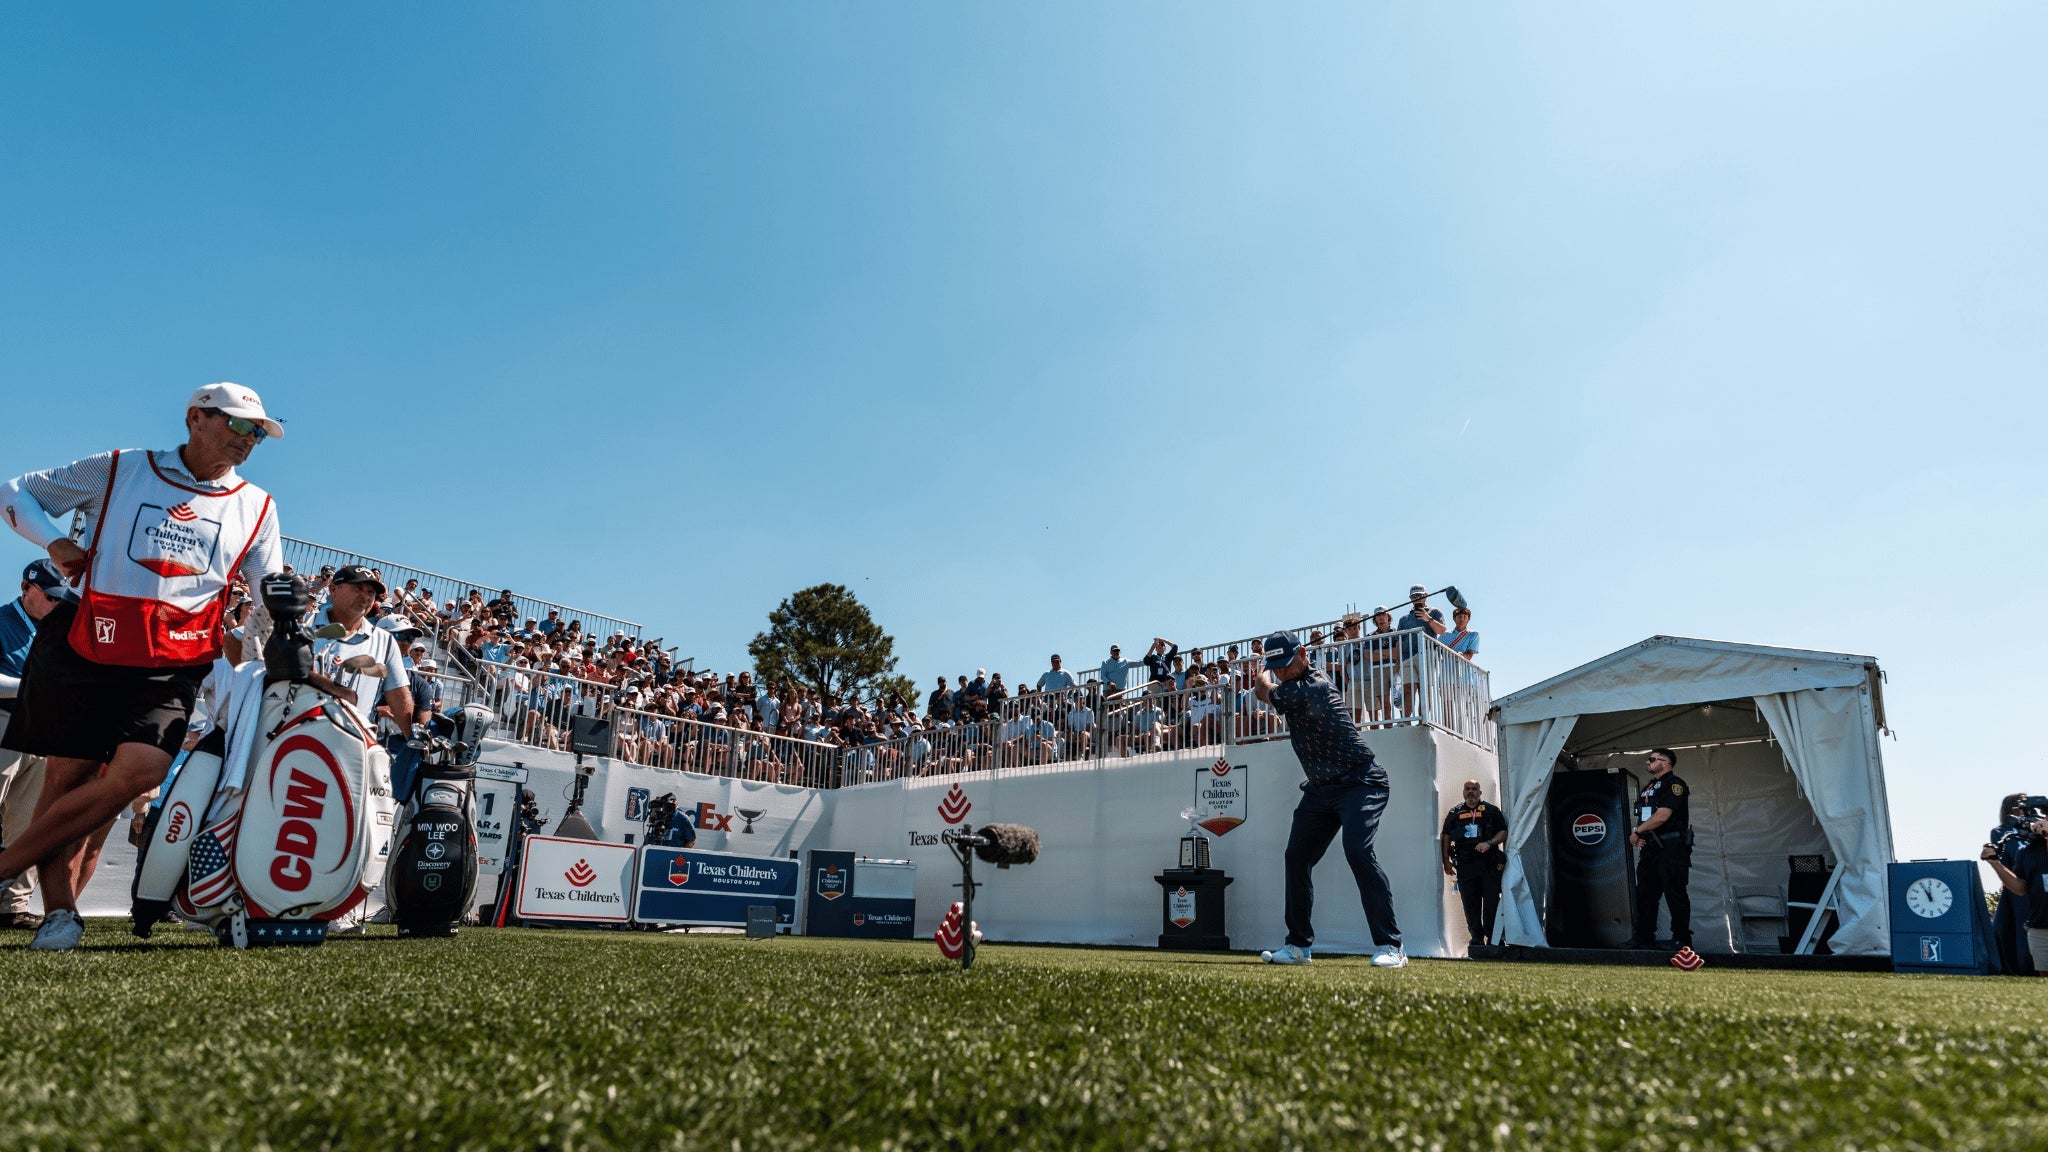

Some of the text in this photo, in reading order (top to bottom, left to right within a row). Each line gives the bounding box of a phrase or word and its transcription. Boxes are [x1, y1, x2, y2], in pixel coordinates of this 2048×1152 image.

[162, 518, 195, 534] Texas
[145, 526, 205, 548] Children's
[153, 539, 192, 551] HOUSTON
[161, 546, 183, 554] OPEN
[466, 711, 483, 760] QUANTUM
[1211, 778, 1232, 788] Texas
[1202, 788, 1240, 799] Children's
[483, 793, 495, 815] 1
[165, 811, 186, 844] CDW
[270, 767, 328, 892] CDW
[436, 824, 458, 832] WOO
[493, 822, 501, 830] 4
[1575, 825, 1604, 833] PEPSI
[428, 832, 445, 840] LEE
[479, 832, 502, 840] YARDS
[908, 831, 938, 846] Texas
[417, 861, 451, 869] Discovery
[697, 862, 778, 880] Texas Children's
[713, 877, 743, 885] HOUSTON
[535, 887, 620, 903] Texas Children's
